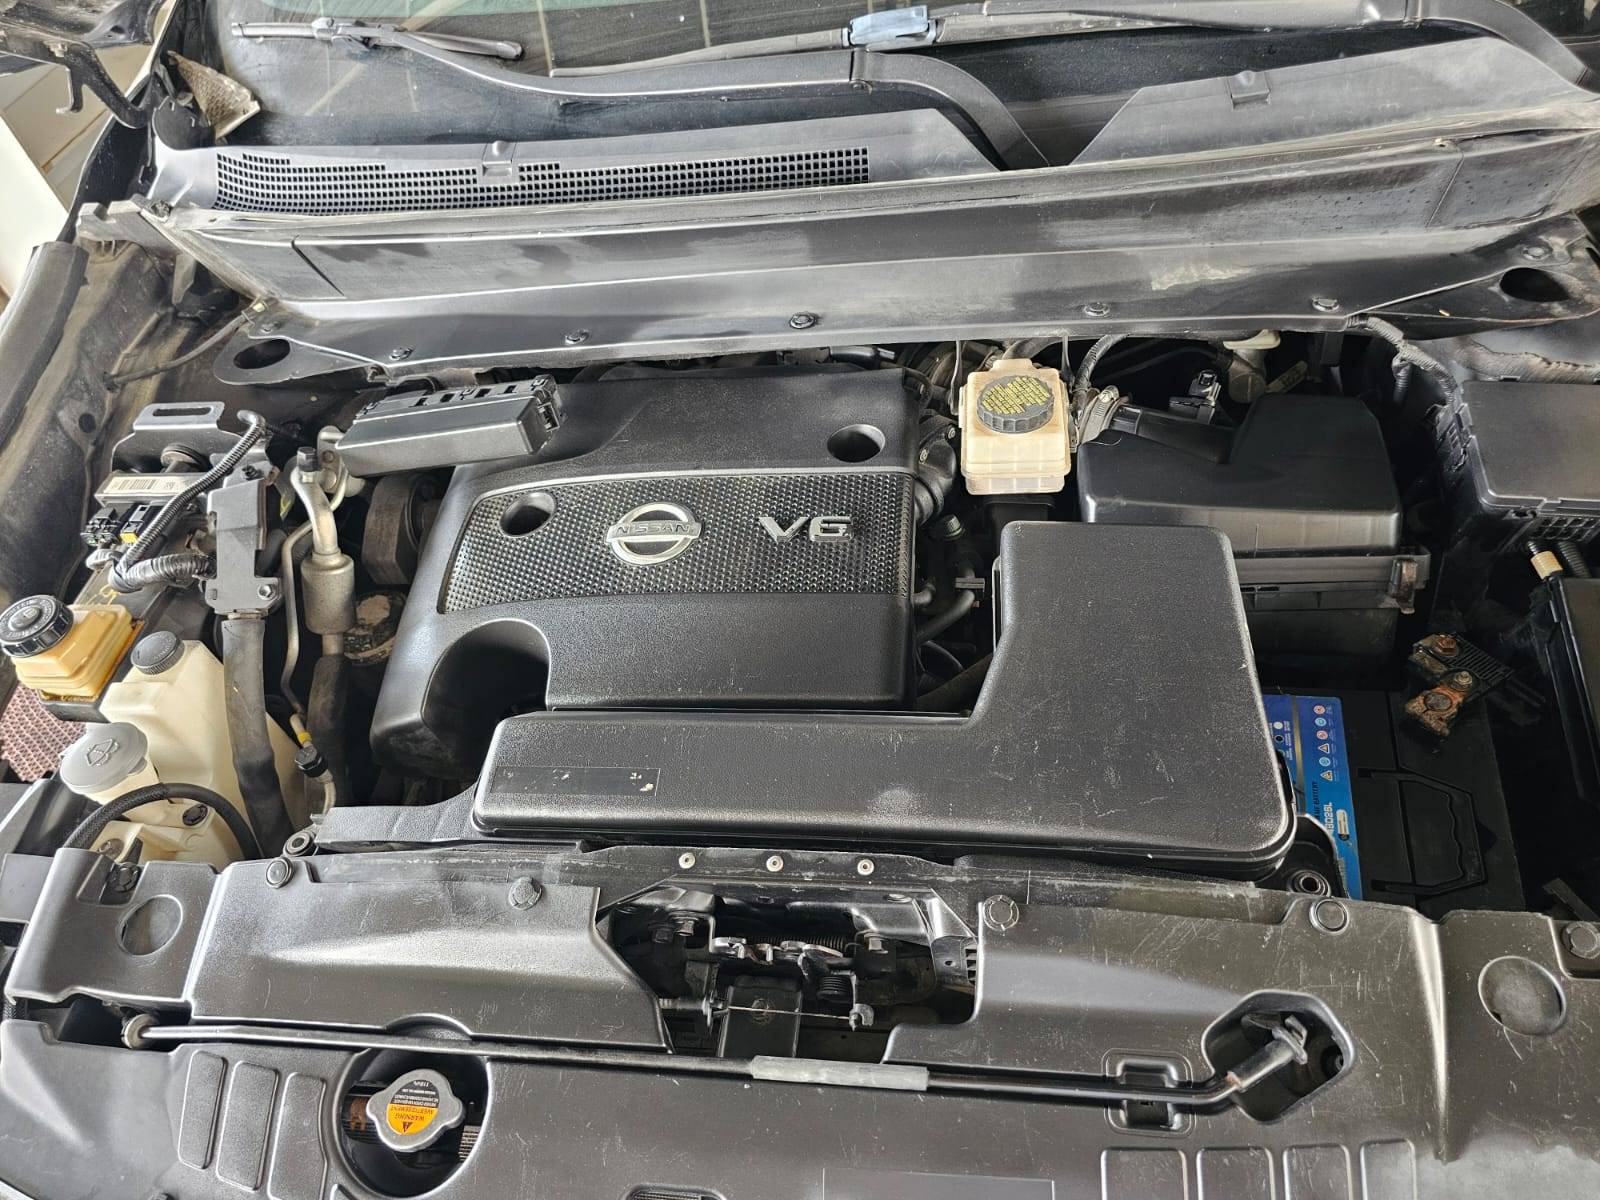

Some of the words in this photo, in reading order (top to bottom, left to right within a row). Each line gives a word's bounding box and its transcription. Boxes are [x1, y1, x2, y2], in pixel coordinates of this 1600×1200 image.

[615, 522, 691, 535] NISSAN
[758, 515, 854, 543] V6
[395, 1113, 425, 1121] WARNING
